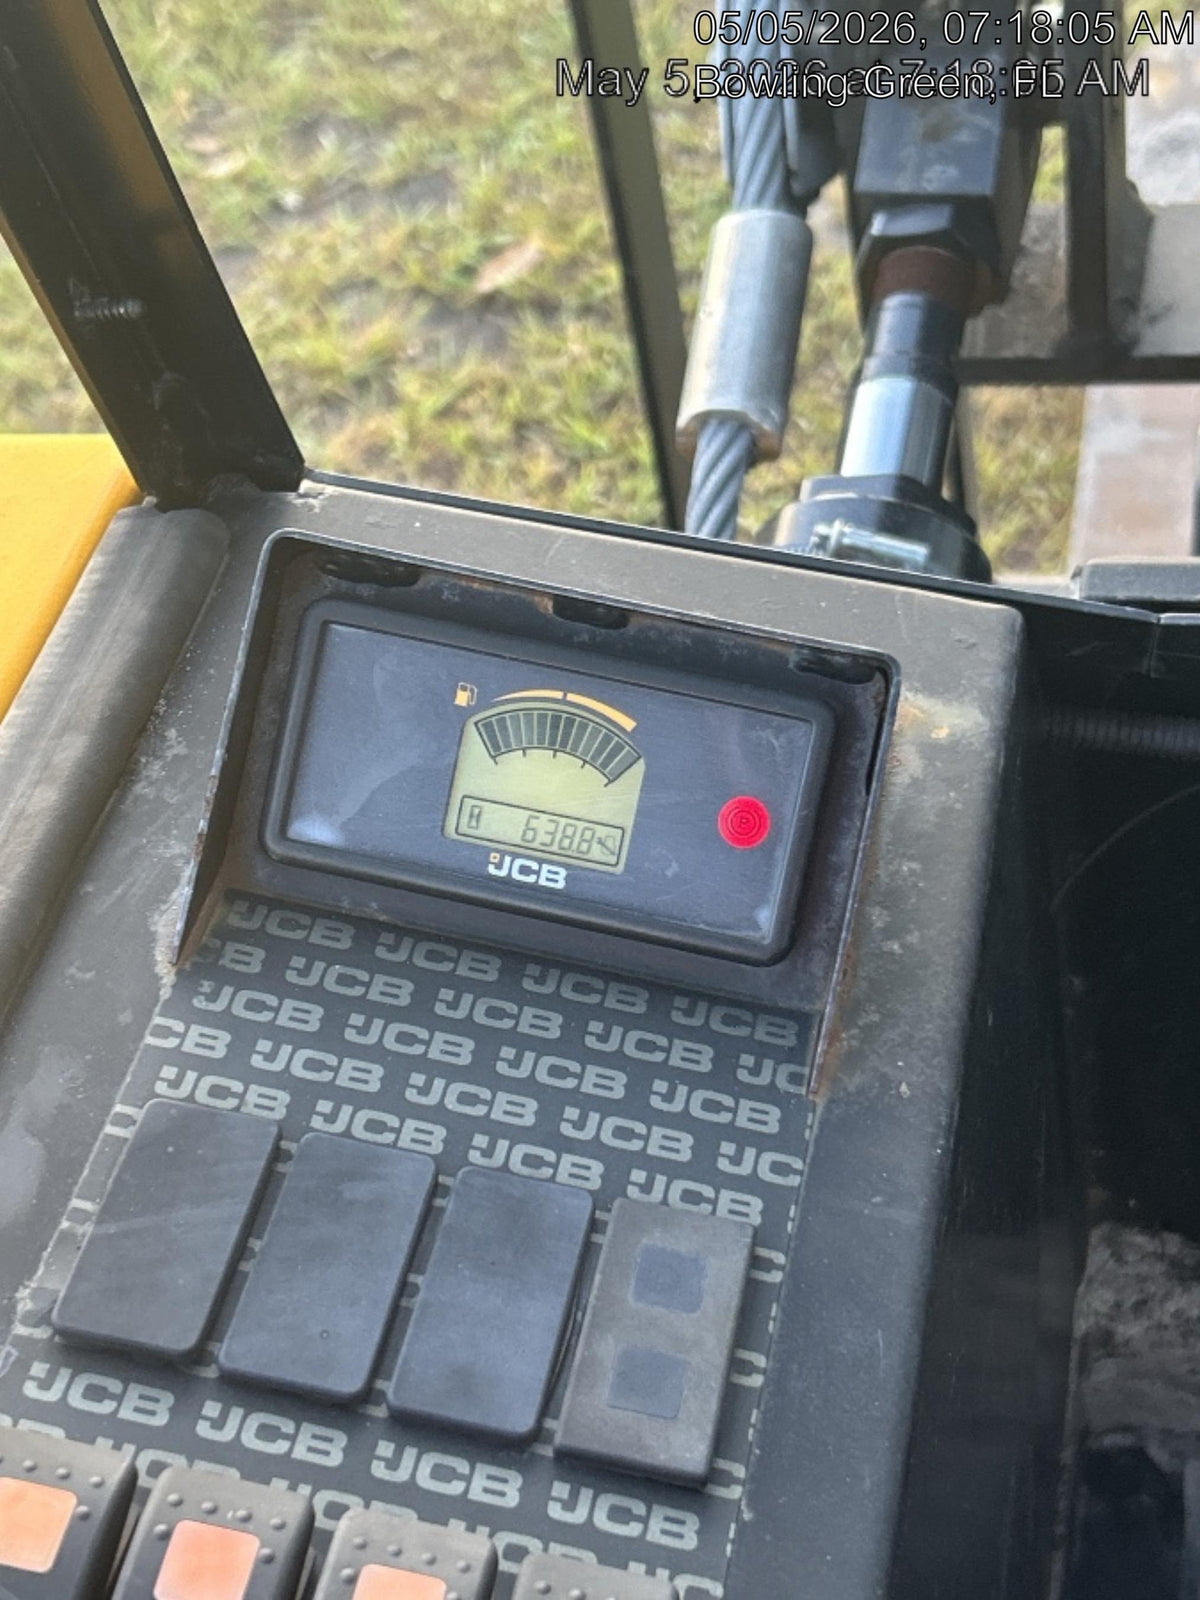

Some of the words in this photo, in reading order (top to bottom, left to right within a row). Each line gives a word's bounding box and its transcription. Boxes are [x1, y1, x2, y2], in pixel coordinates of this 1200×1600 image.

[487, 852, 567, 889] JCB
[227, 900, 355, 950] JCB
[375, 931, 502, 982] JCB
[522, 963, 649, 1014] JCB
[670, 995, 798, 1047] JCB
[285, 956, 415, 1007] JCB
[434, 988, 563, 1039] JCB
[585, 1020, 714, 1073] JCB
[736, 1054, 809, 1095] JC
[144, 1017, 231, 1059] CB
[251, 1039, 385, 1092] JCB
[405, 1073, 539, 1127] JCB
[560, 1106, 694, 1162] JCB
[717, 1141, 805, 1187] JC
[192, 980, 324, 1032] JCB
[344, 1013, 475, 1065] JCB
[496, 1045, 628, 1099] JCB
[650, 1079, 781, 1134] JCB
[154, 1065, 291, 1120] JCB
[309, 1100, 447, 1155] JCB
[467, 1132, 605, 1190] JCB
[627, 1168, 763, 1226] JCB
[22, 1362, 174, 1426] JCB
[196, 1400, 348, 1467] JCB
[371, 1439, 523, 1508] JCB
[547, 1480, 700, 1551] JCB
